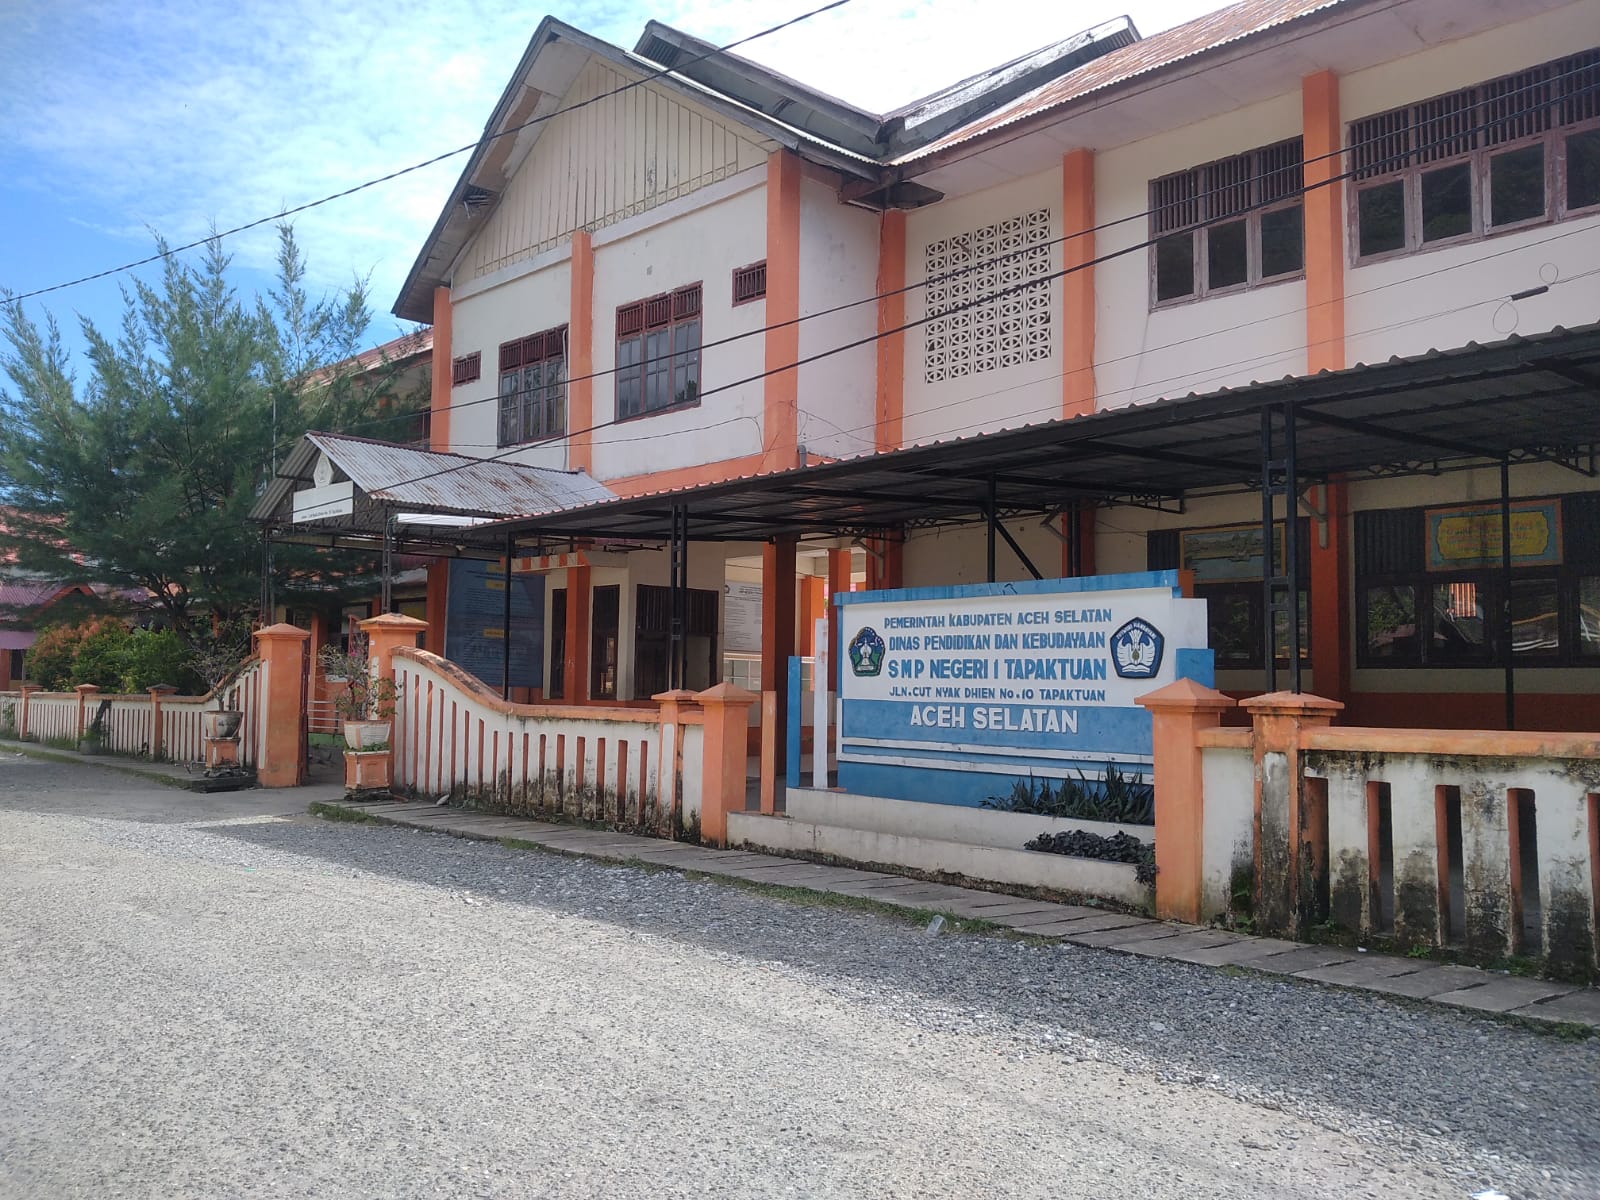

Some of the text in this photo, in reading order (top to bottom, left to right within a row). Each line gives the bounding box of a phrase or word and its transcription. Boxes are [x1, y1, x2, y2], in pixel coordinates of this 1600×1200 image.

[884, 609, 1112, 629] PEMERINTAH KABUPATEN ACEH SELATAN
[889, 632, 1105, 650] DINAS PENDIDIKAN DAN KEBUDAYAAN
[888, 659, 924, 679] SMP
[929, 658, 989, 679] NEGERI
[1004, 658, 1106, 680] TAPAKTUAN
[935, 687, 960, 698] NYAK
[964, 688, 995, 699] DHIEN
[1039, 688, 1105, 701] TAPAKTUAN
[910, 705, 1078, 733] ACEH SELATAN
